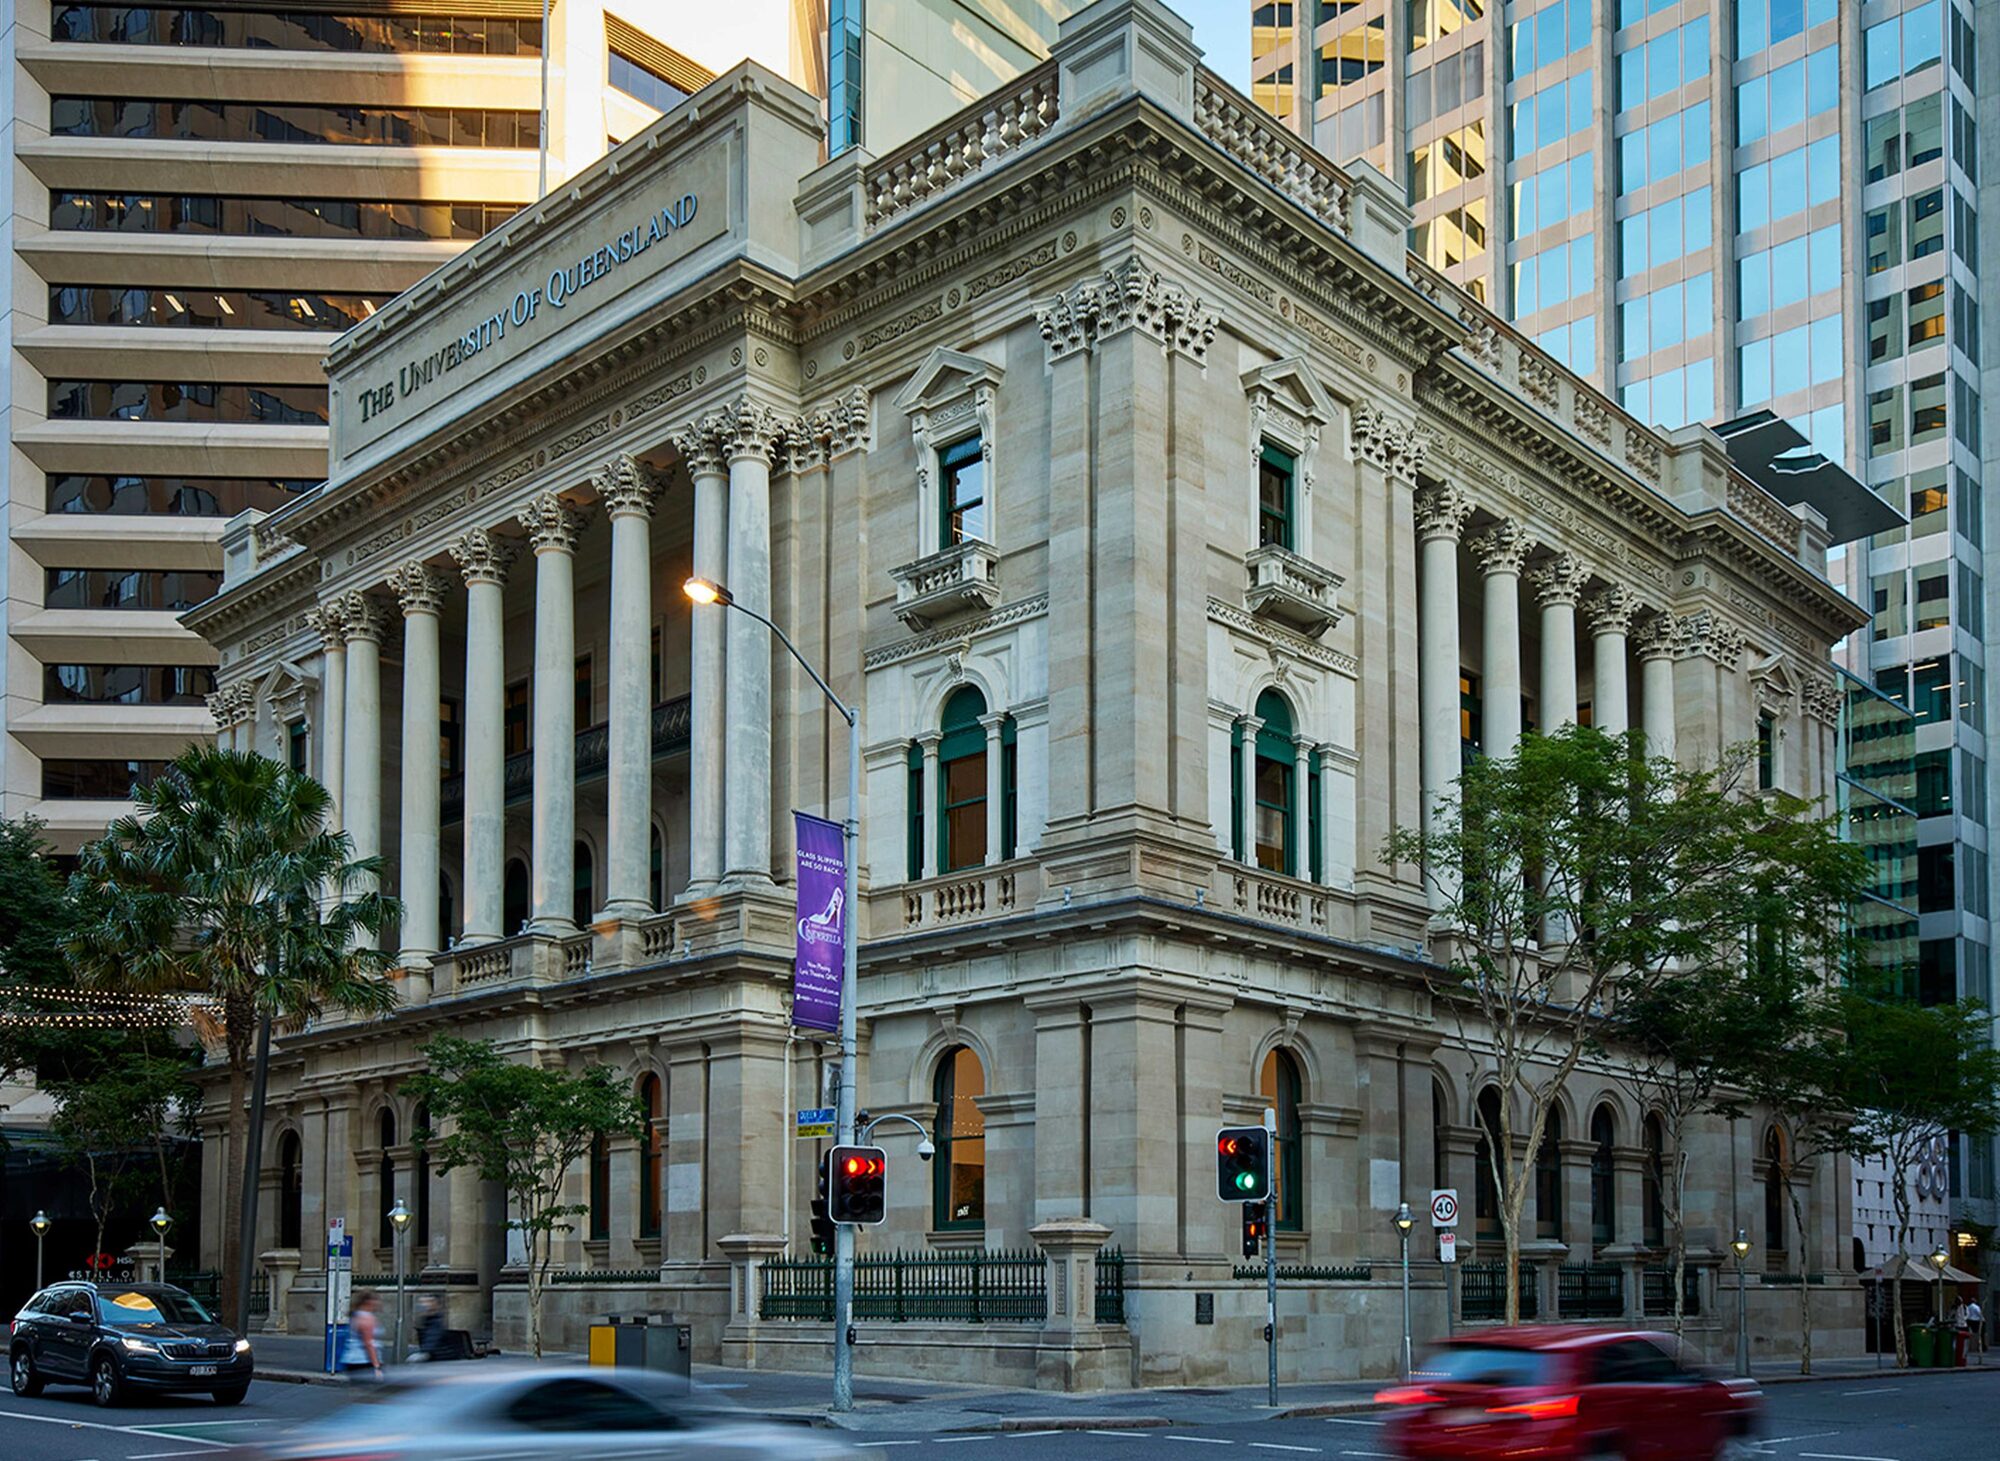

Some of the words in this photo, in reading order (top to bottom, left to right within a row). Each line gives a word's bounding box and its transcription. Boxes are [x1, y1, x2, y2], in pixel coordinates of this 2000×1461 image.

[358, 382, 394, 422] THE
[399, 308, 509, 398] UNIVERSITY
[511, 288, 542, 327] OF
[546, 192, 698, 309] QUEENSLAND
[797, 850, 816, 860] GLASS
[817, 855, 843, 867] SLIPPERS
[800, 860, 812, 868] ARE
[813, 862, 822, 871] SO
[1436, 1201, 1453, 1214] 40
